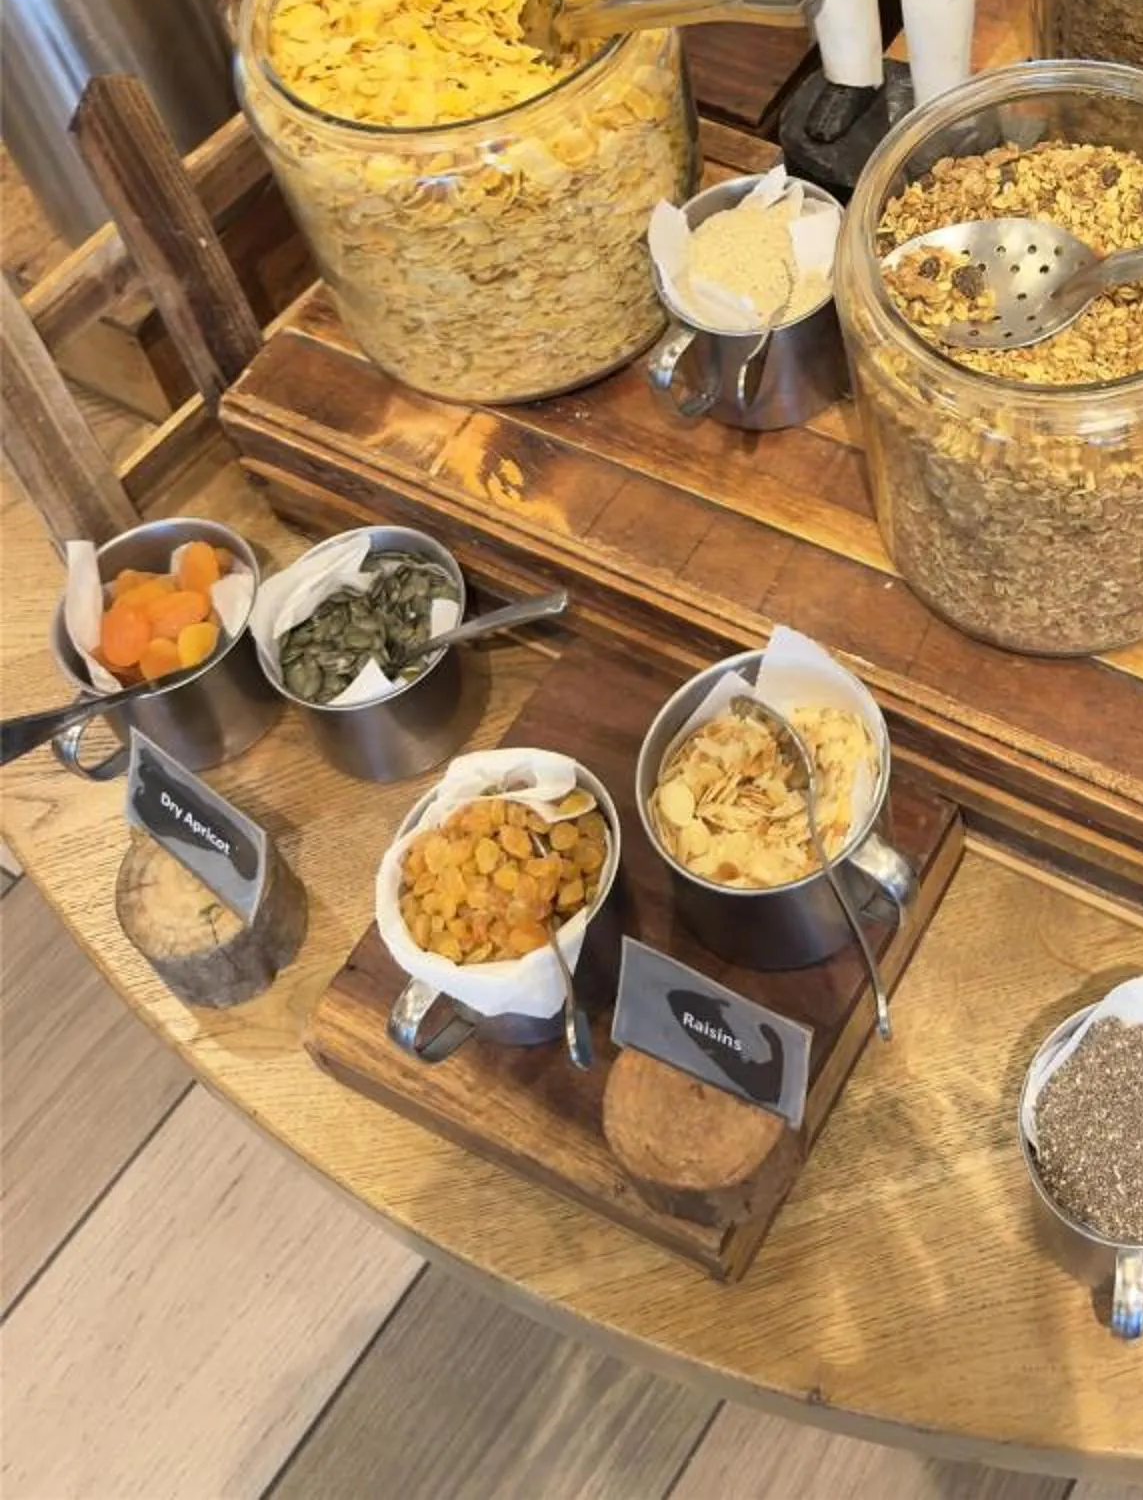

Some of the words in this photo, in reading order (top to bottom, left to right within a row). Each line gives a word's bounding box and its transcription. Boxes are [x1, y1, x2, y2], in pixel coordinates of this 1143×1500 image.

[159, 791, 183, 820] Dry
[183, 812, 231, 854] Apricot
[682, 1011, 743, 1052] Raisins
